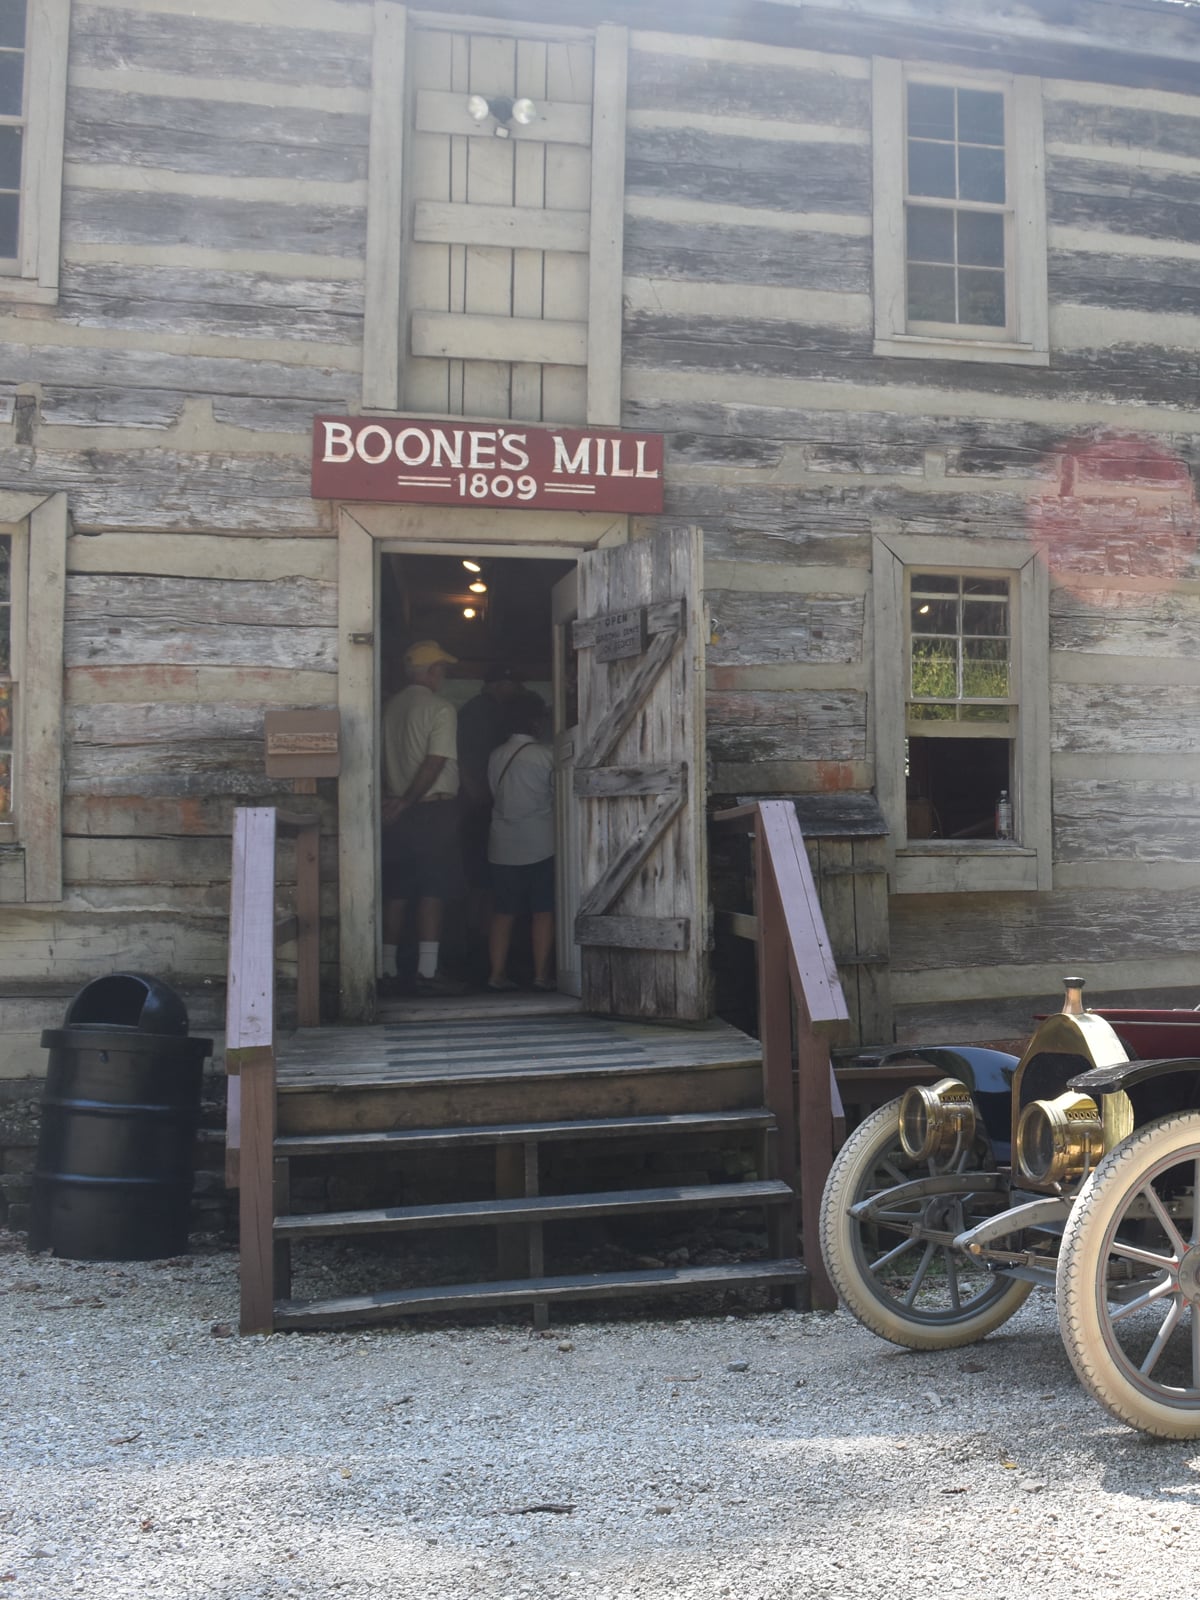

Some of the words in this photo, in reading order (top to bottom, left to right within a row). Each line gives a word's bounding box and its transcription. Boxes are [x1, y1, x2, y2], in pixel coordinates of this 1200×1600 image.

[322, 422, 529, 471] BOONE'S
[552, 436, 658, 479] MILL
[457, 473, 537, 500] 1809
[605, 613, 628, 627] OPEN
